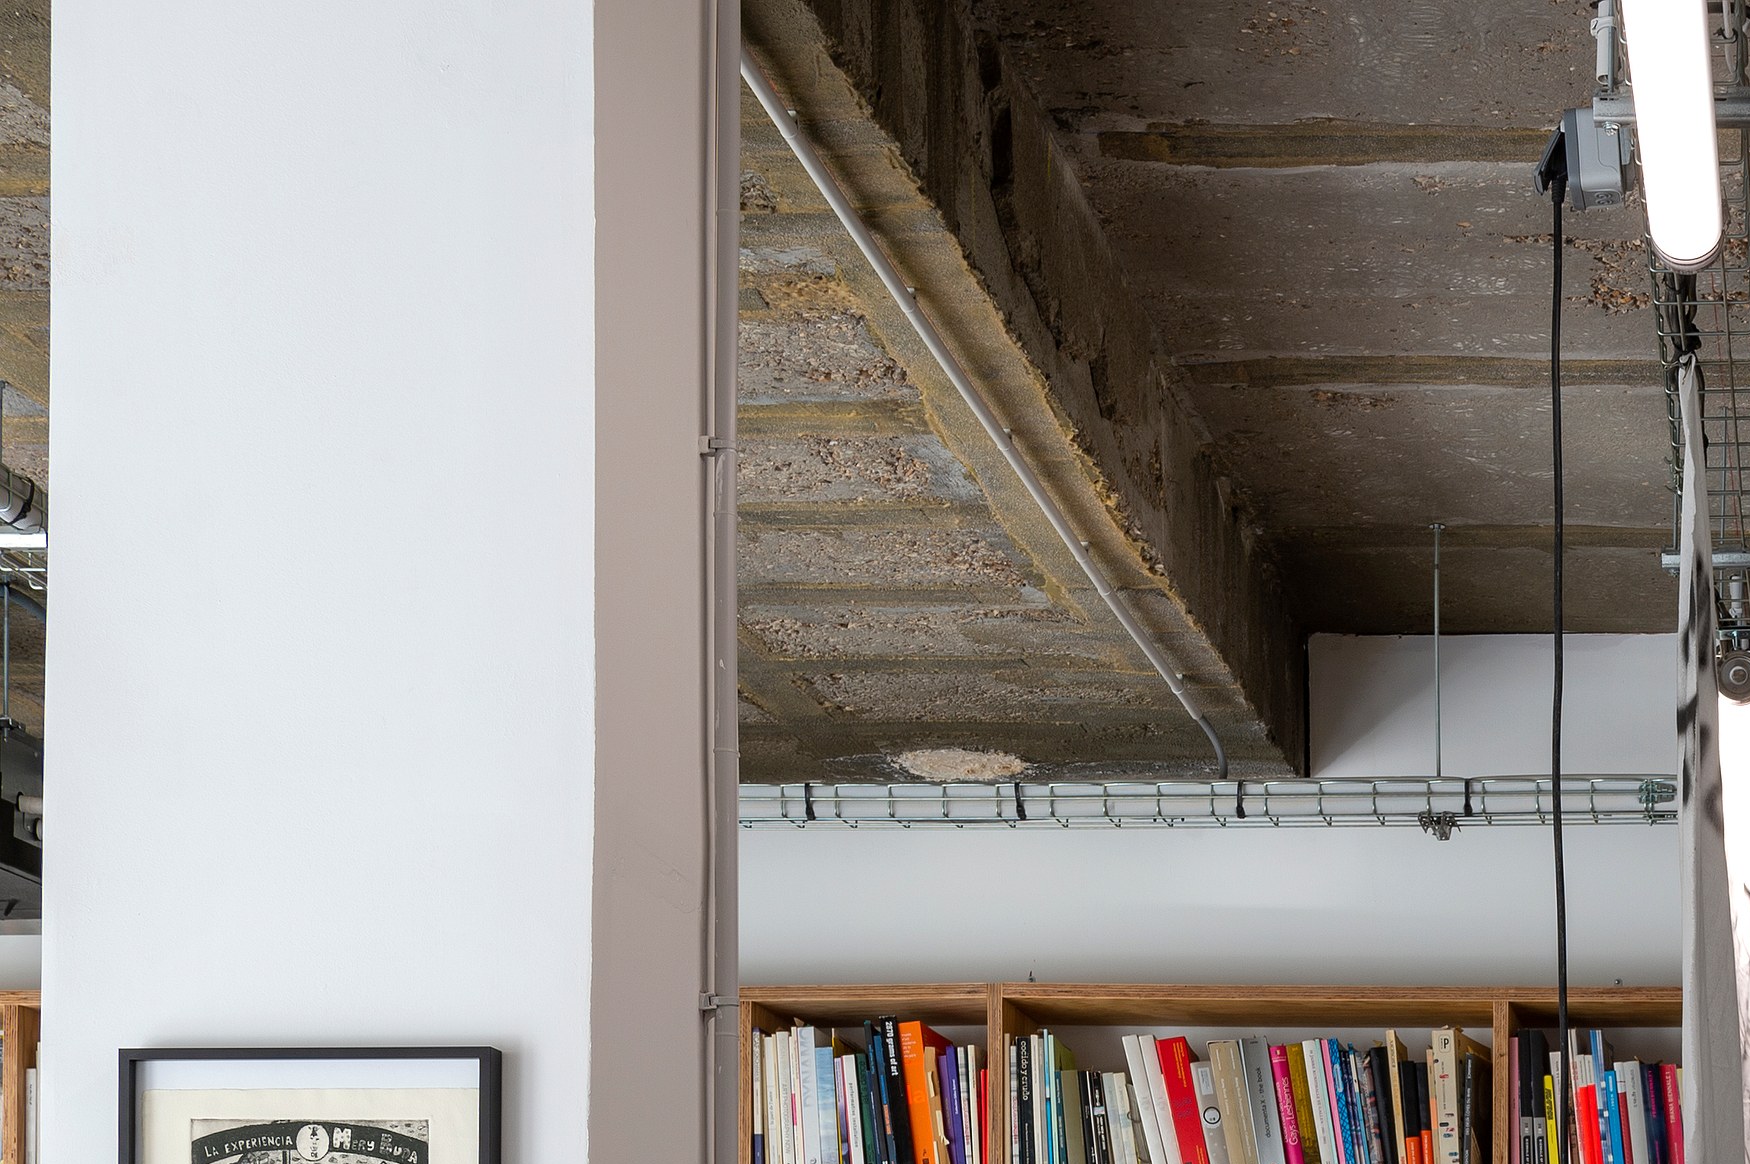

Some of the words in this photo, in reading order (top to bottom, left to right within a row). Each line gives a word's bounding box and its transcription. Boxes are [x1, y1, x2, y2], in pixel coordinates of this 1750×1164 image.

[883, 1020, 894, 1037] 2870
[885, 1037, 896, 1058] grams
[1019, 1040, 1028, 1068] cocido
[888, 1057, 897, 1066] of
[889, 1065, 899, 1076] art
[1253, 1066, 1263, 1083] book
[1020, 1075, 1030, 1101] crudo
[1256, 1083, 1264, 1094] the
[1279, 1075, 1294, 1120] Lesbiennes
[1259, 1104, 1271, 1138] documenta
[1286, 1124, 1299, 1145] Gays
[223, 1135, 295, 1155] EXPERIENCIA
